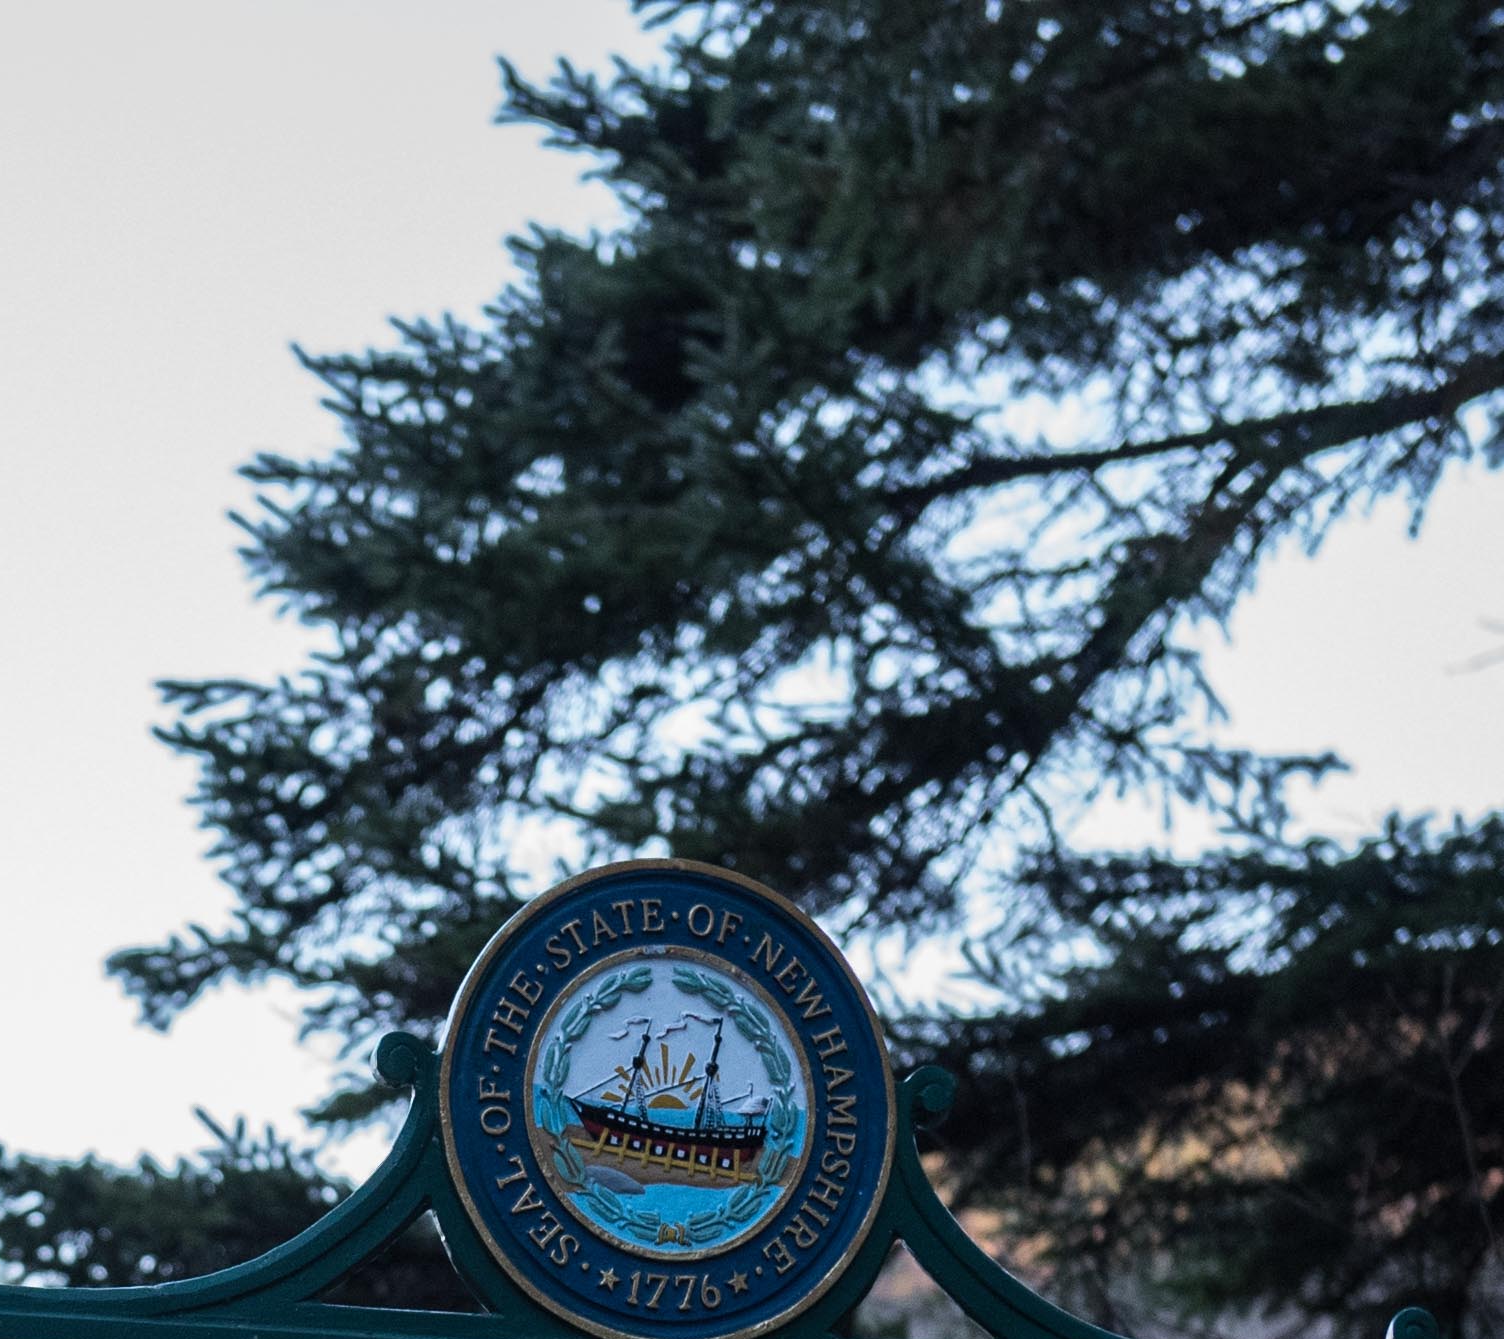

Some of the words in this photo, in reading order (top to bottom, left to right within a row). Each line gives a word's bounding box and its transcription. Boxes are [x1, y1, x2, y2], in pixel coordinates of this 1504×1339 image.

[545, 898, 666, 971] STATE
[687, 902, 743, 945] OF
[483, 969, 545, 1057] THE
[749, 931, 833, 1020] NEW
[478, 1075, 512, 1136] OF
[762, 1024, 859, 1275] HAMPSHIRE
[495, 1153, 581, 1267] SEAL
[625, 1269, 722, 1311] 1776
